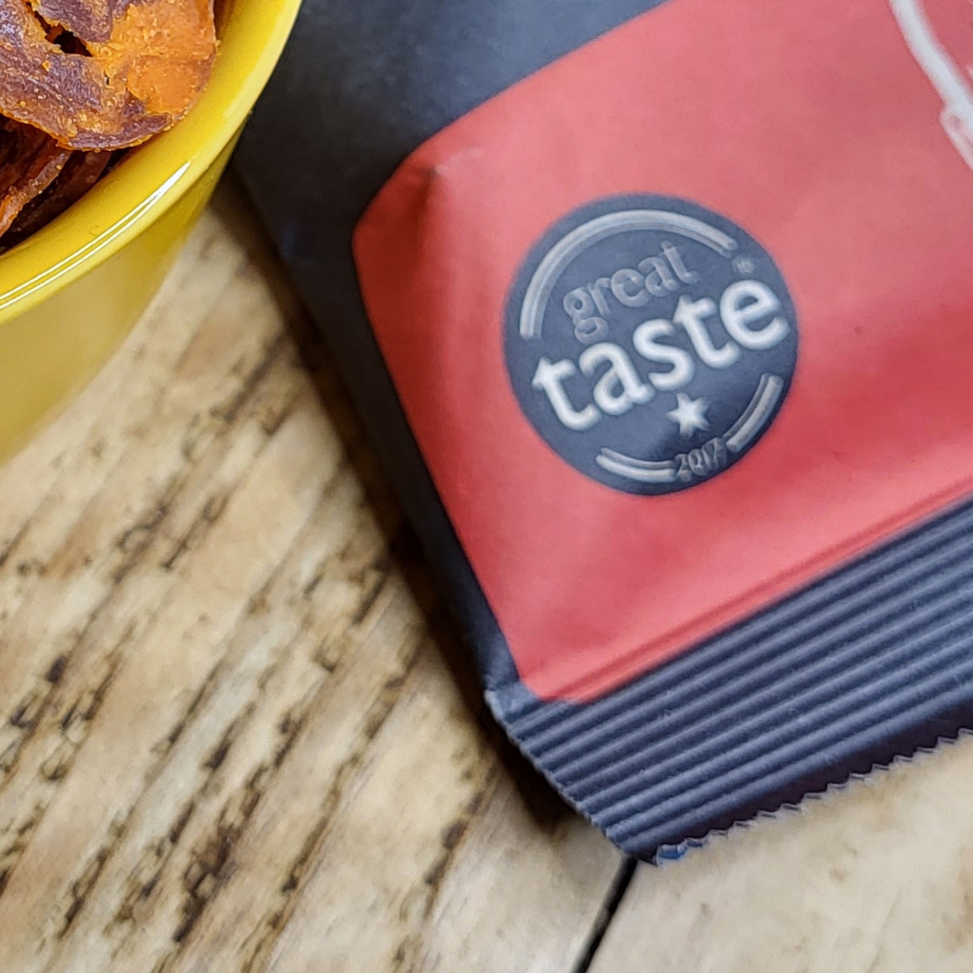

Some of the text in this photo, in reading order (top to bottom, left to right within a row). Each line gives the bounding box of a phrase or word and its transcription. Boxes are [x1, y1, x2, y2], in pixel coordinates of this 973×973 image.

[562, 240, 698, 344] great
[530, 279, 791, 431] taste
[674, 436, 724, 482] 2017
